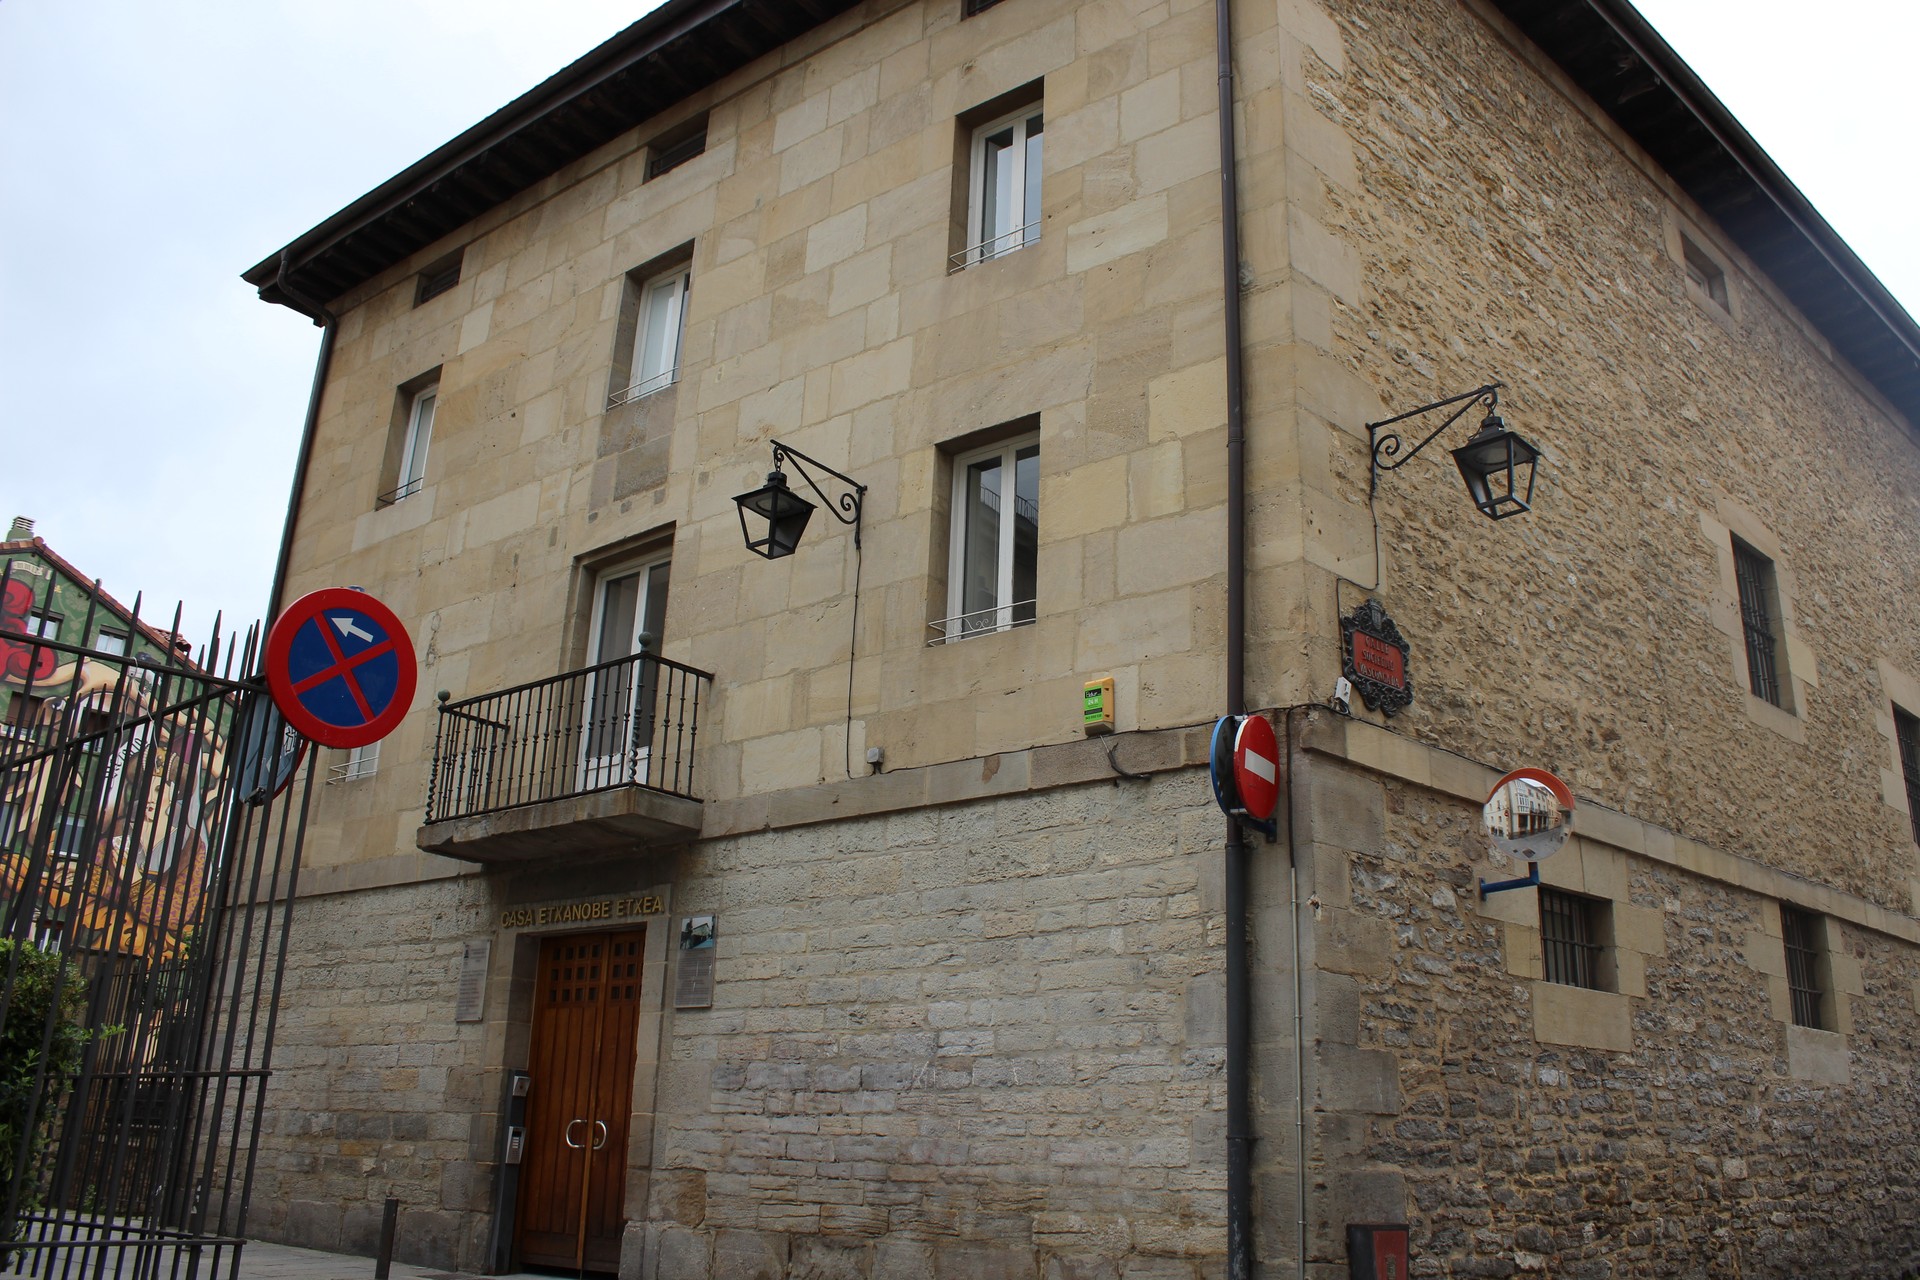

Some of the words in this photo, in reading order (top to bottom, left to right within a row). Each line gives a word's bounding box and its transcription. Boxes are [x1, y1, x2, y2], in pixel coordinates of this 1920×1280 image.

[1365, 635, 1389, 655] CALLE
[501, 910, 534, 928] CASA
[537, 901, 611, 925] ETXANOBE
[616, 895, 665, 917] ETXEA
